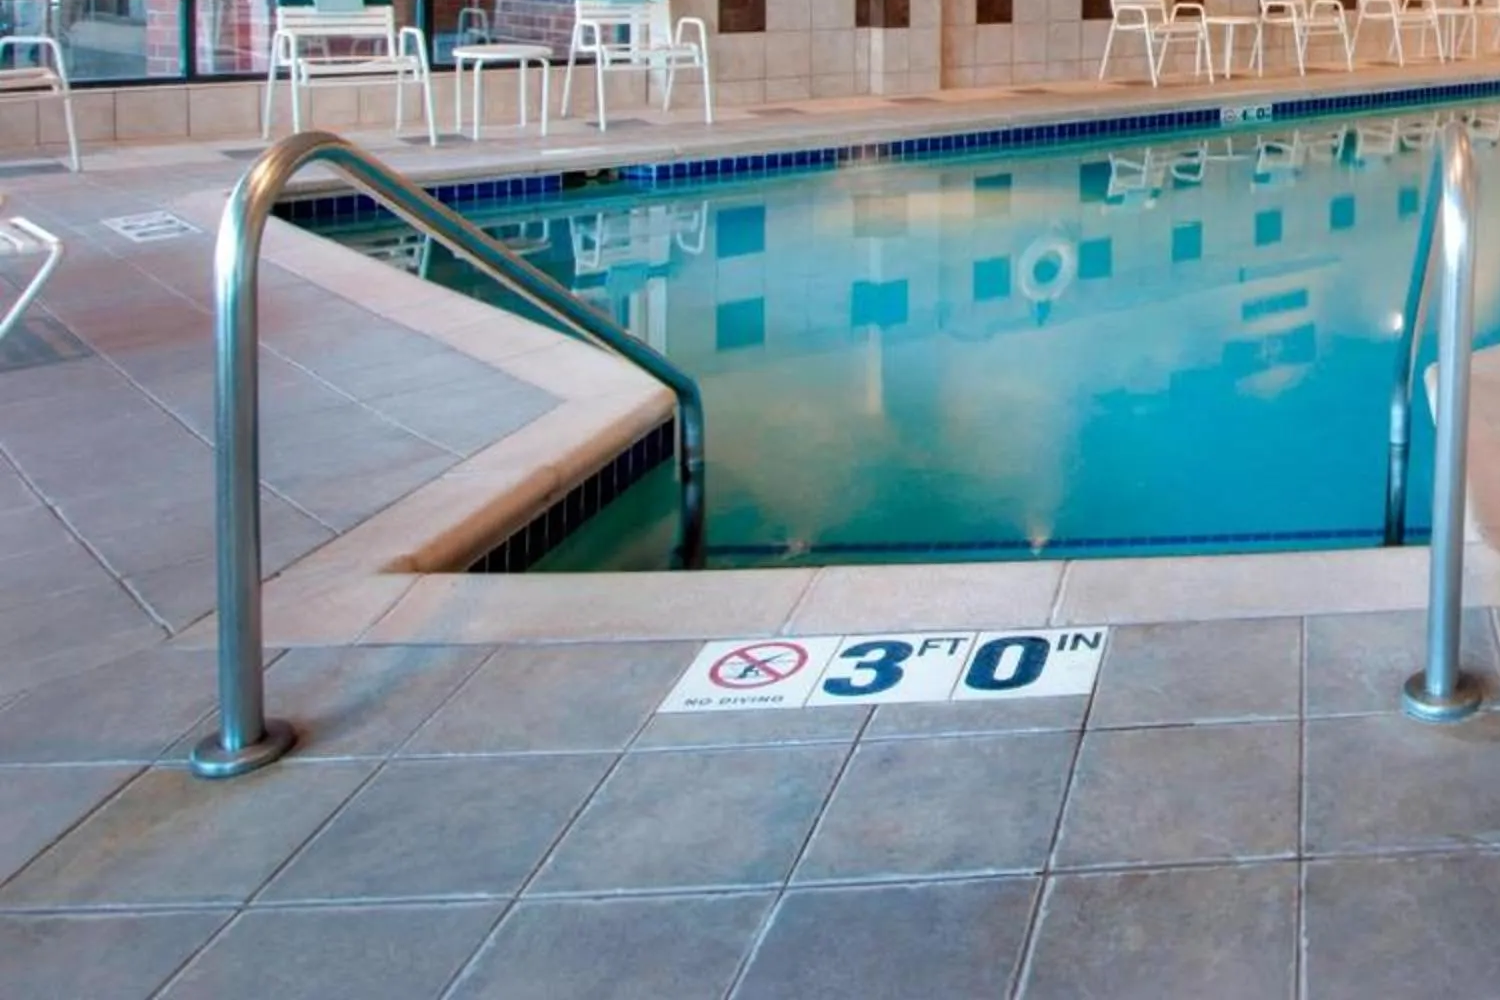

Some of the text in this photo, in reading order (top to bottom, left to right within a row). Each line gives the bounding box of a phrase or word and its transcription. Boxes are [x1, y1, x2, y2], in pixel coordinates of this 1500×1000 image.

[822, 632, 1103, 697] 3 FT 0 IN
[684, 695, 784, 706] NO DIVING
